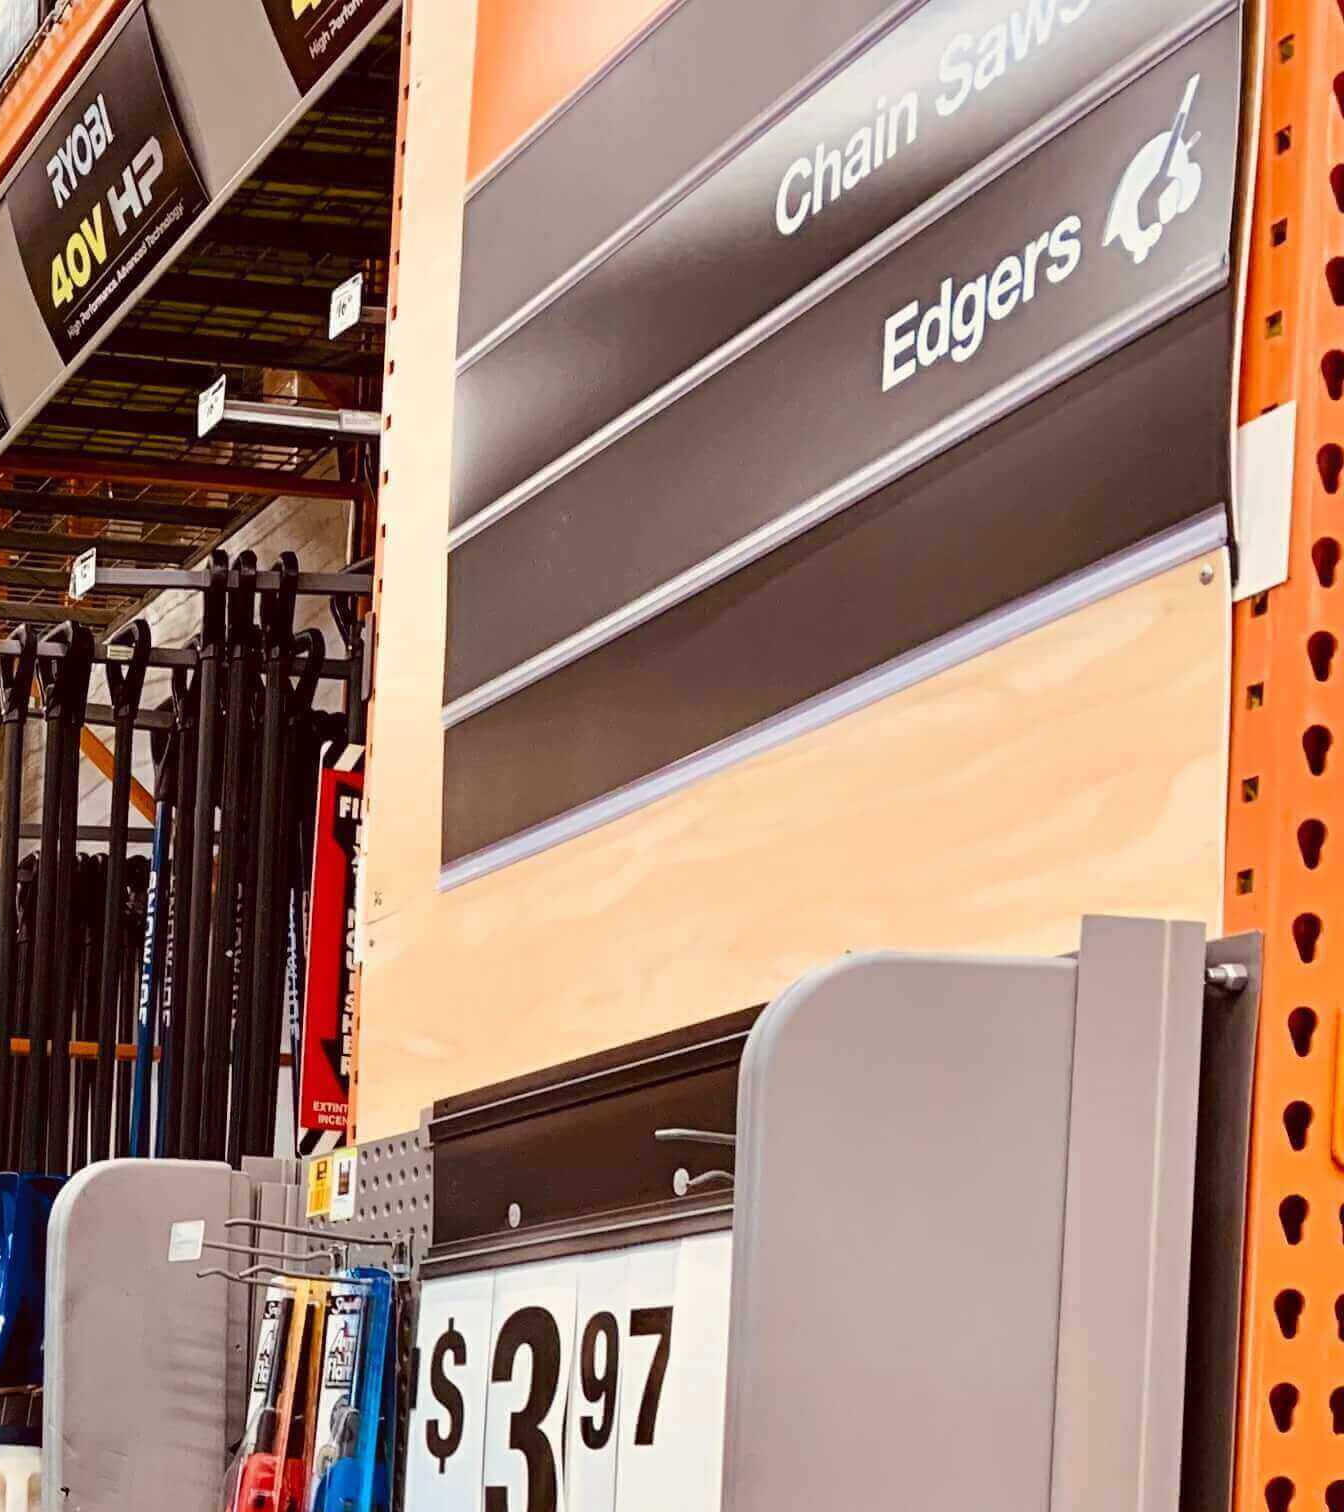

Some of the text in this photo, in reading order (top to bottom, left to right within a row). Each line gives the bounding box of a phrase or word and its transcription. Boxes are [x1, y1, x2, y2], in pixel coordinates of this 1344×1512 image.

[309, 30, 331, 59] High
[45, 93, 115, 210] RYOBI
[775, 0, 1096, 238] Chain Saws
[49, 135, 165, 310] 40V HP
[67, 319, 81, 340] High
[79, 279, 118, 325] Performance
[116, 241, 147, 282] Advanced
[881, 214, 1083, 395] Edgers
[312, 1101, 348, 1113] EXTINT
[318, 1114, 348, 1125] INCEN
